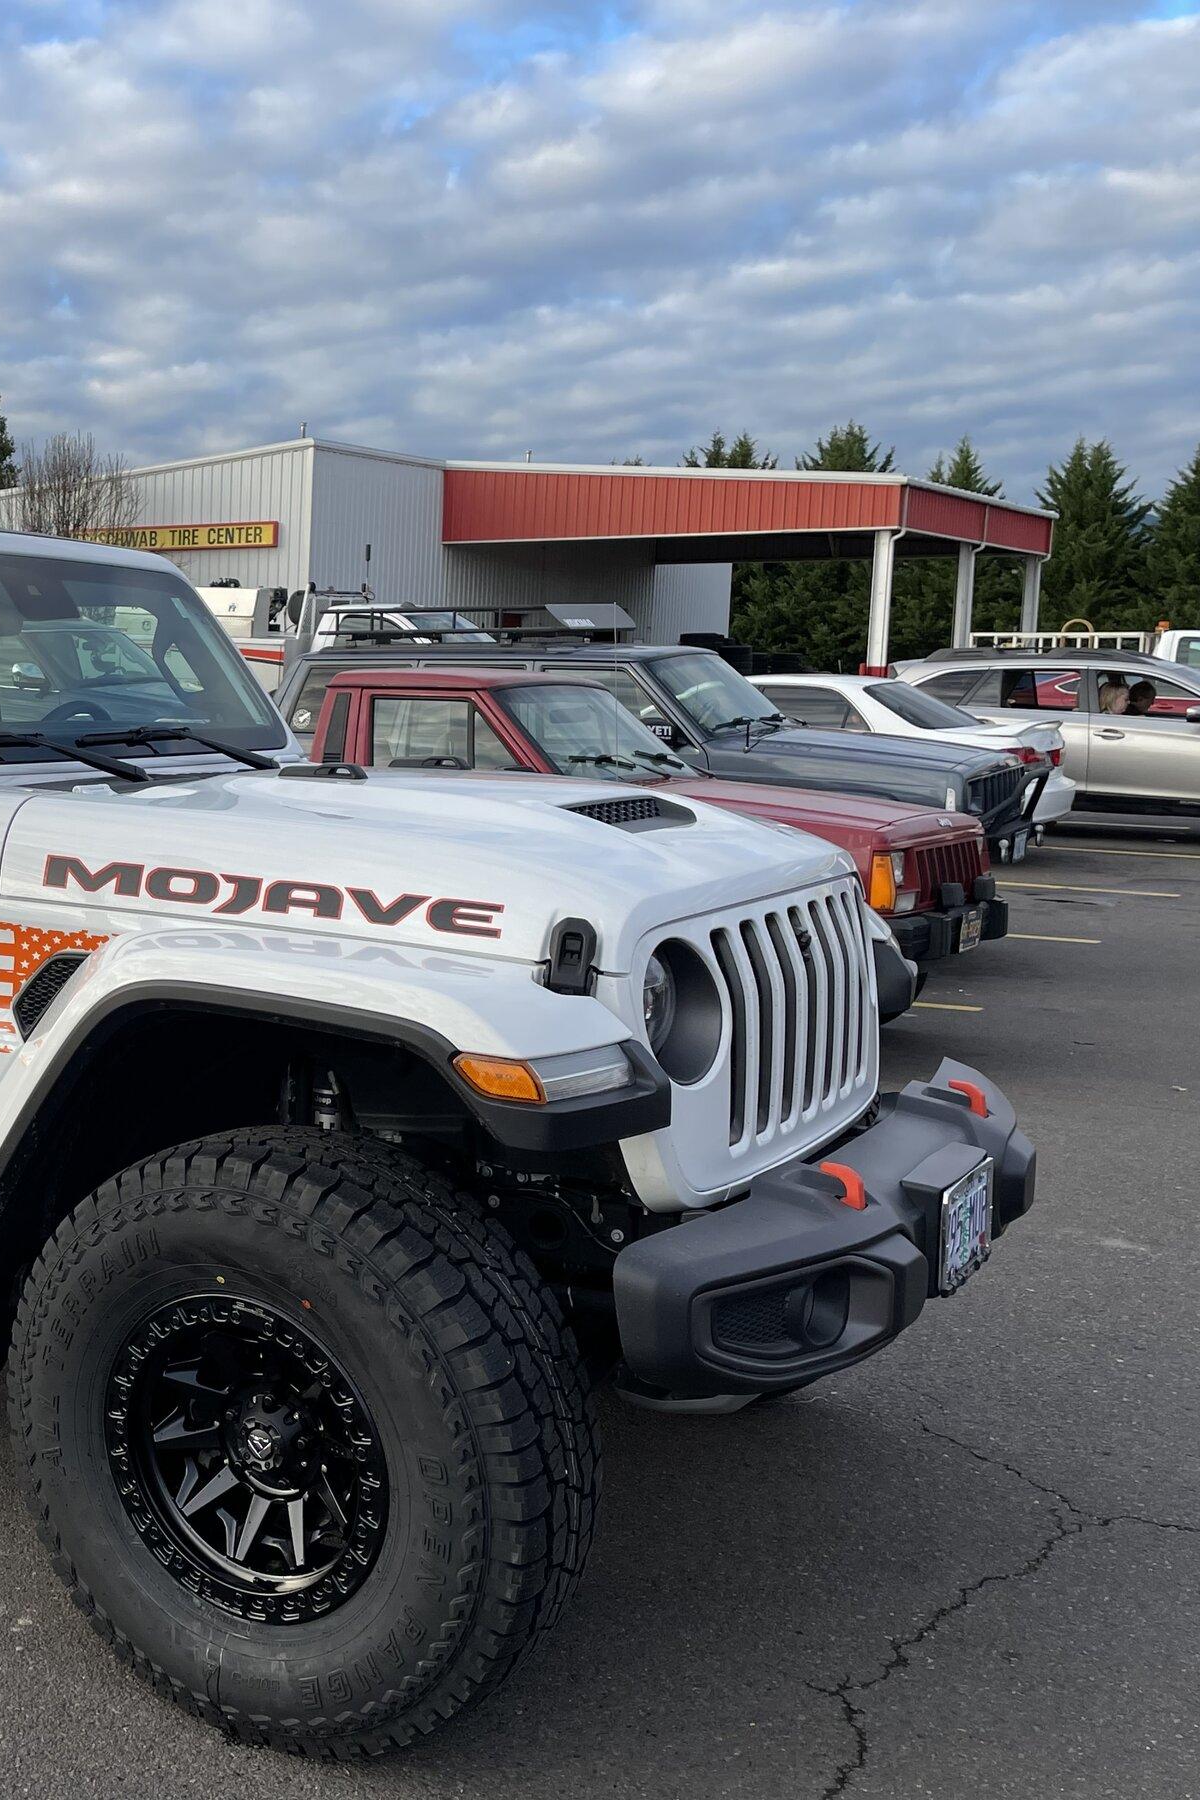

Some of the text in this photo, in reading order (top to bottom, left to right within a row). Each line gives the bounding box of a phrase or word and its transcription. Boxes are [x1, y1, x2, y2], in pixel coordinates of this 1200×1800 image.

[169, 528, 199, 546] TIRE
[207, 526, 263, 544] CENTER
[647, 725, 672, 736] YETI
[43, 854, 504, 939] MOJAVE
[42, 1227, 161, 1371] TERRAIN
[298, 1453, 453, 1710] OPEN RANGE
